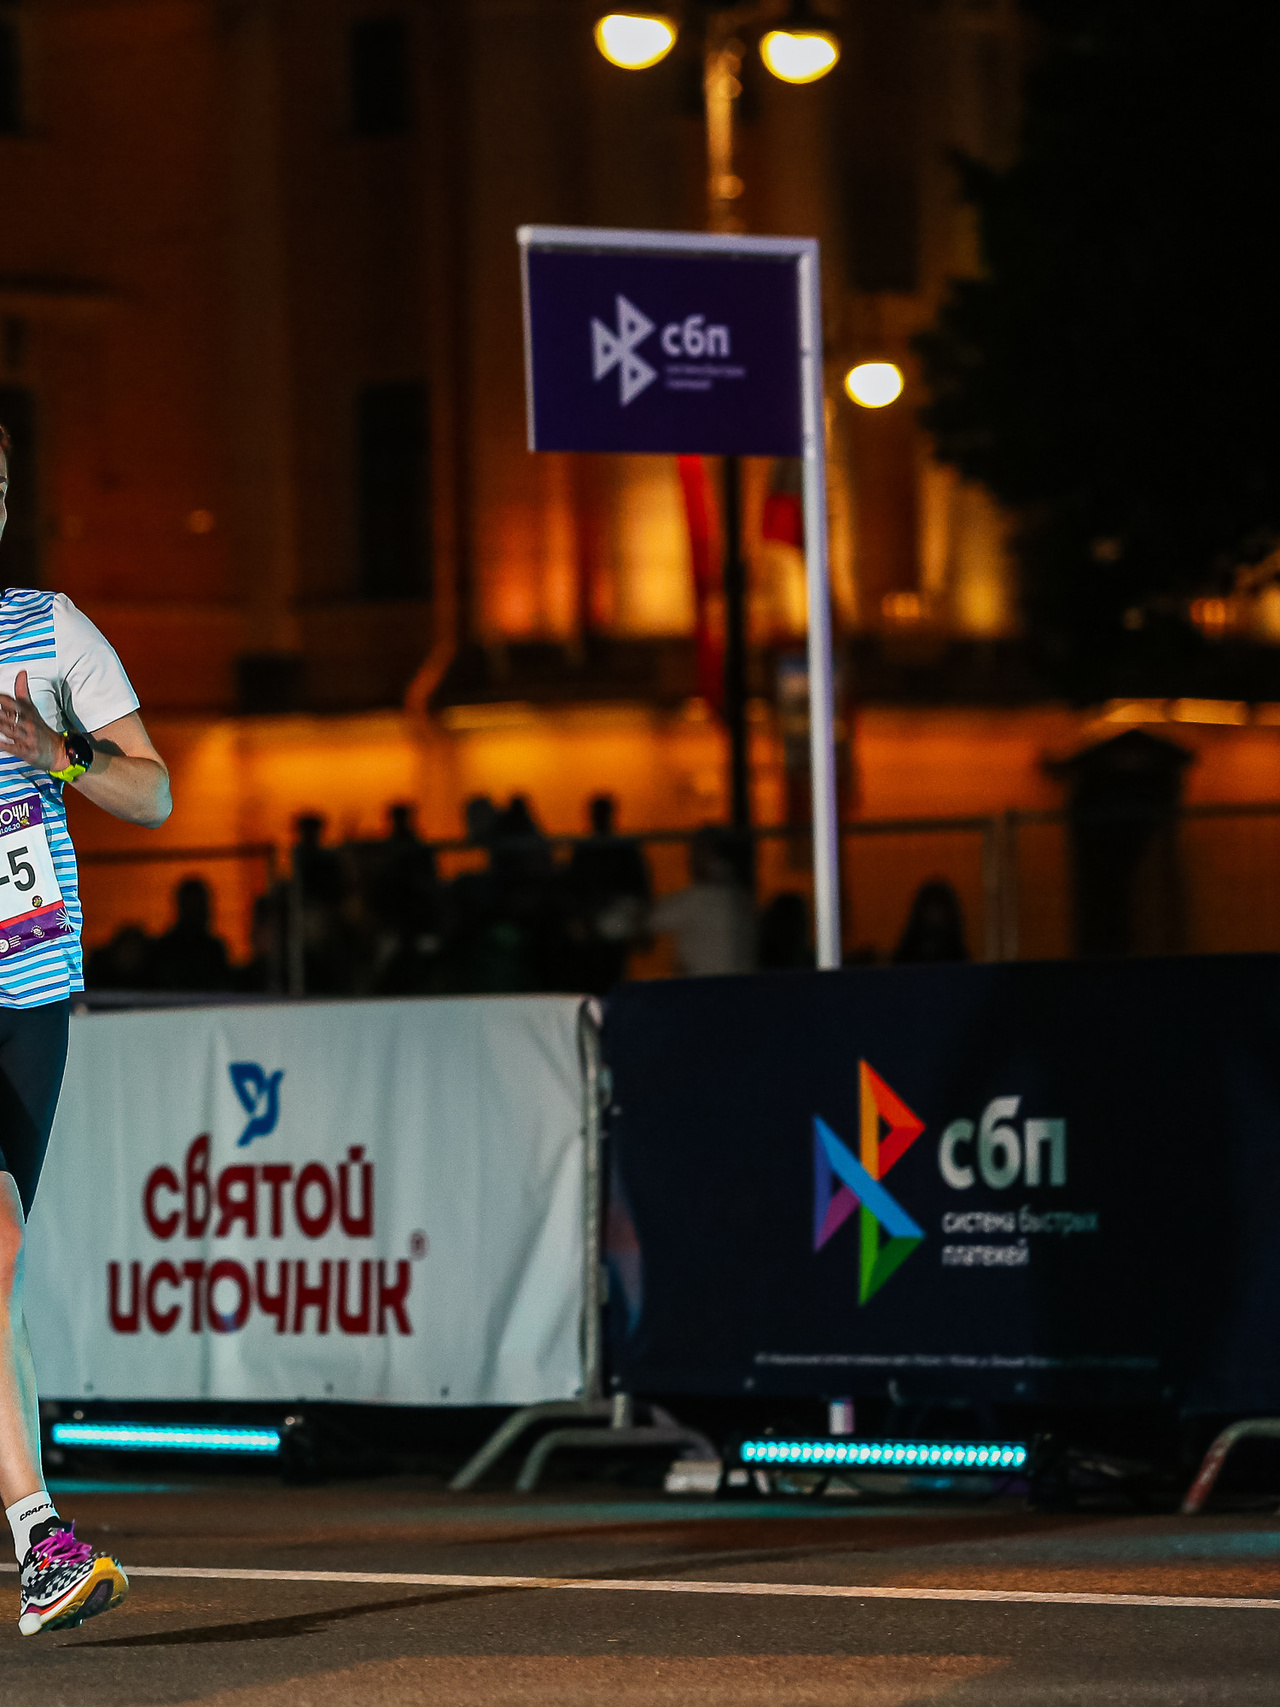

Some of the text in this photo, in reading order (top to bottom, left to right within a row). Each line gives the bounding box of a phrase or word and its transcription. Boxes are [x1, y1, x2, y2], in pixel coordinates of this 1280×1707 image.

[661, 313, 730, 357] сбп
[937, 1094, 1067, 1190] сбп
[19, 1503, 50, 1521] CRAFT
